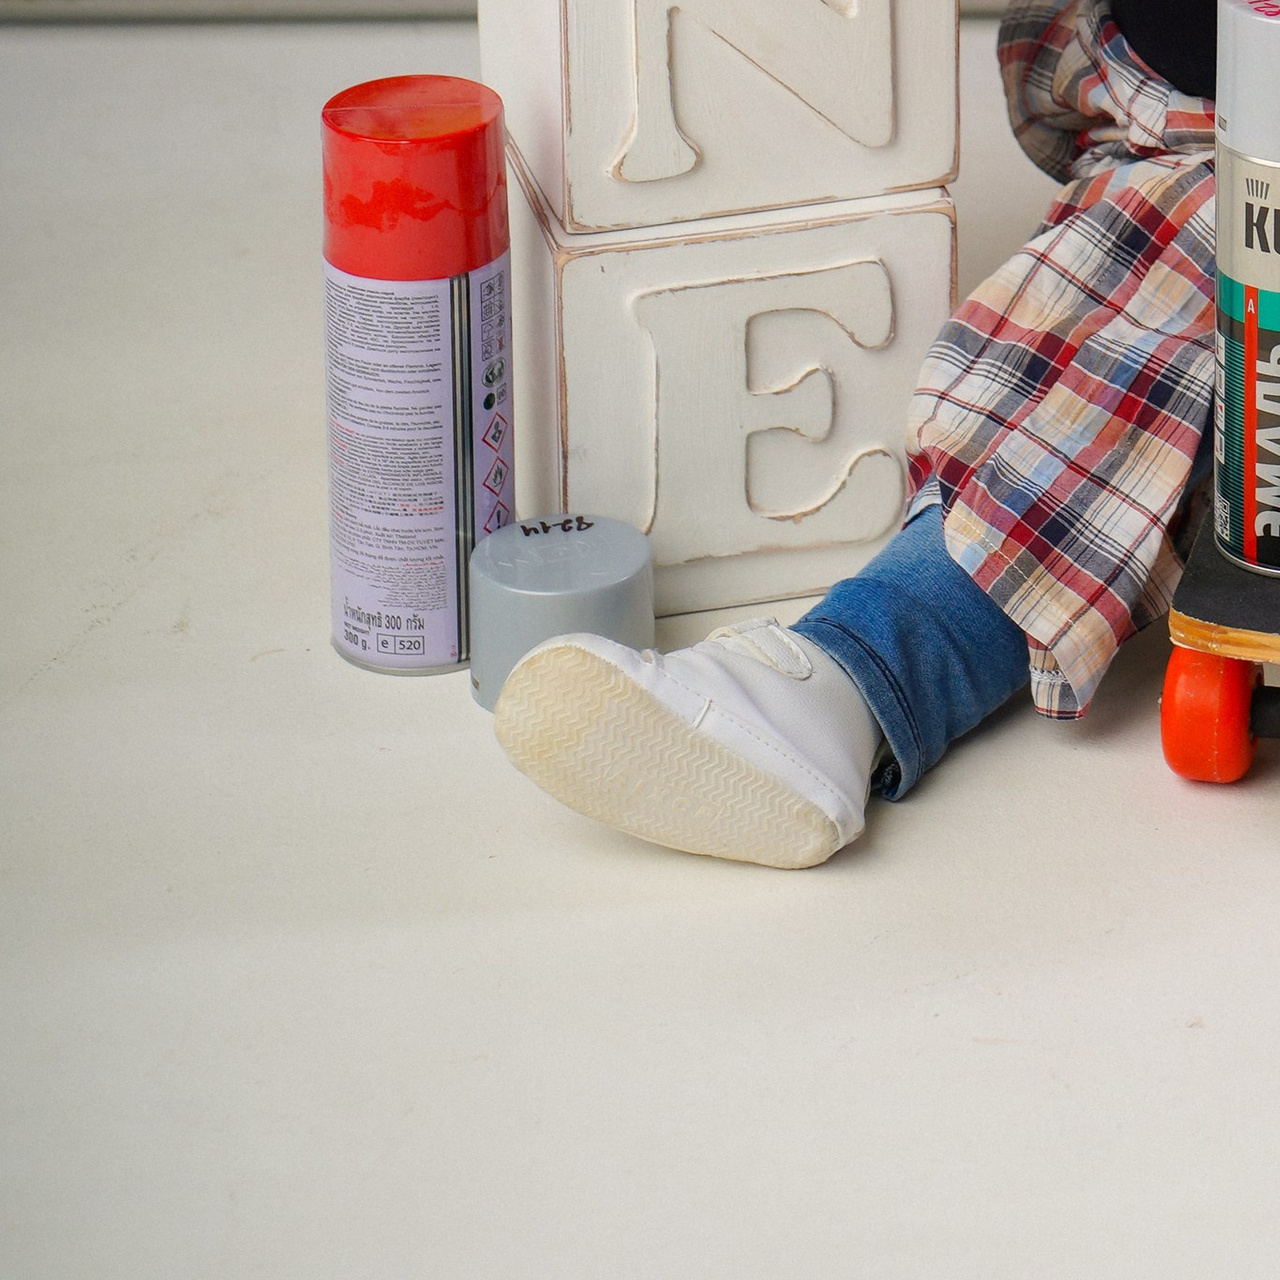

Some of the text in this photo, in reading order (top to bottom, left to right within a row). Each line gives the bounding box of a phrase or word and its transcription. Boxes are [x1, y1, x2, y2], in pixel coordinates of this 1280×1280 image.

[384, 615, 401, 630] 300
[406, 614, 424, 630] กรัม
[344, 629, 358, 645] 300
[399, 640, 421, 650] 520
